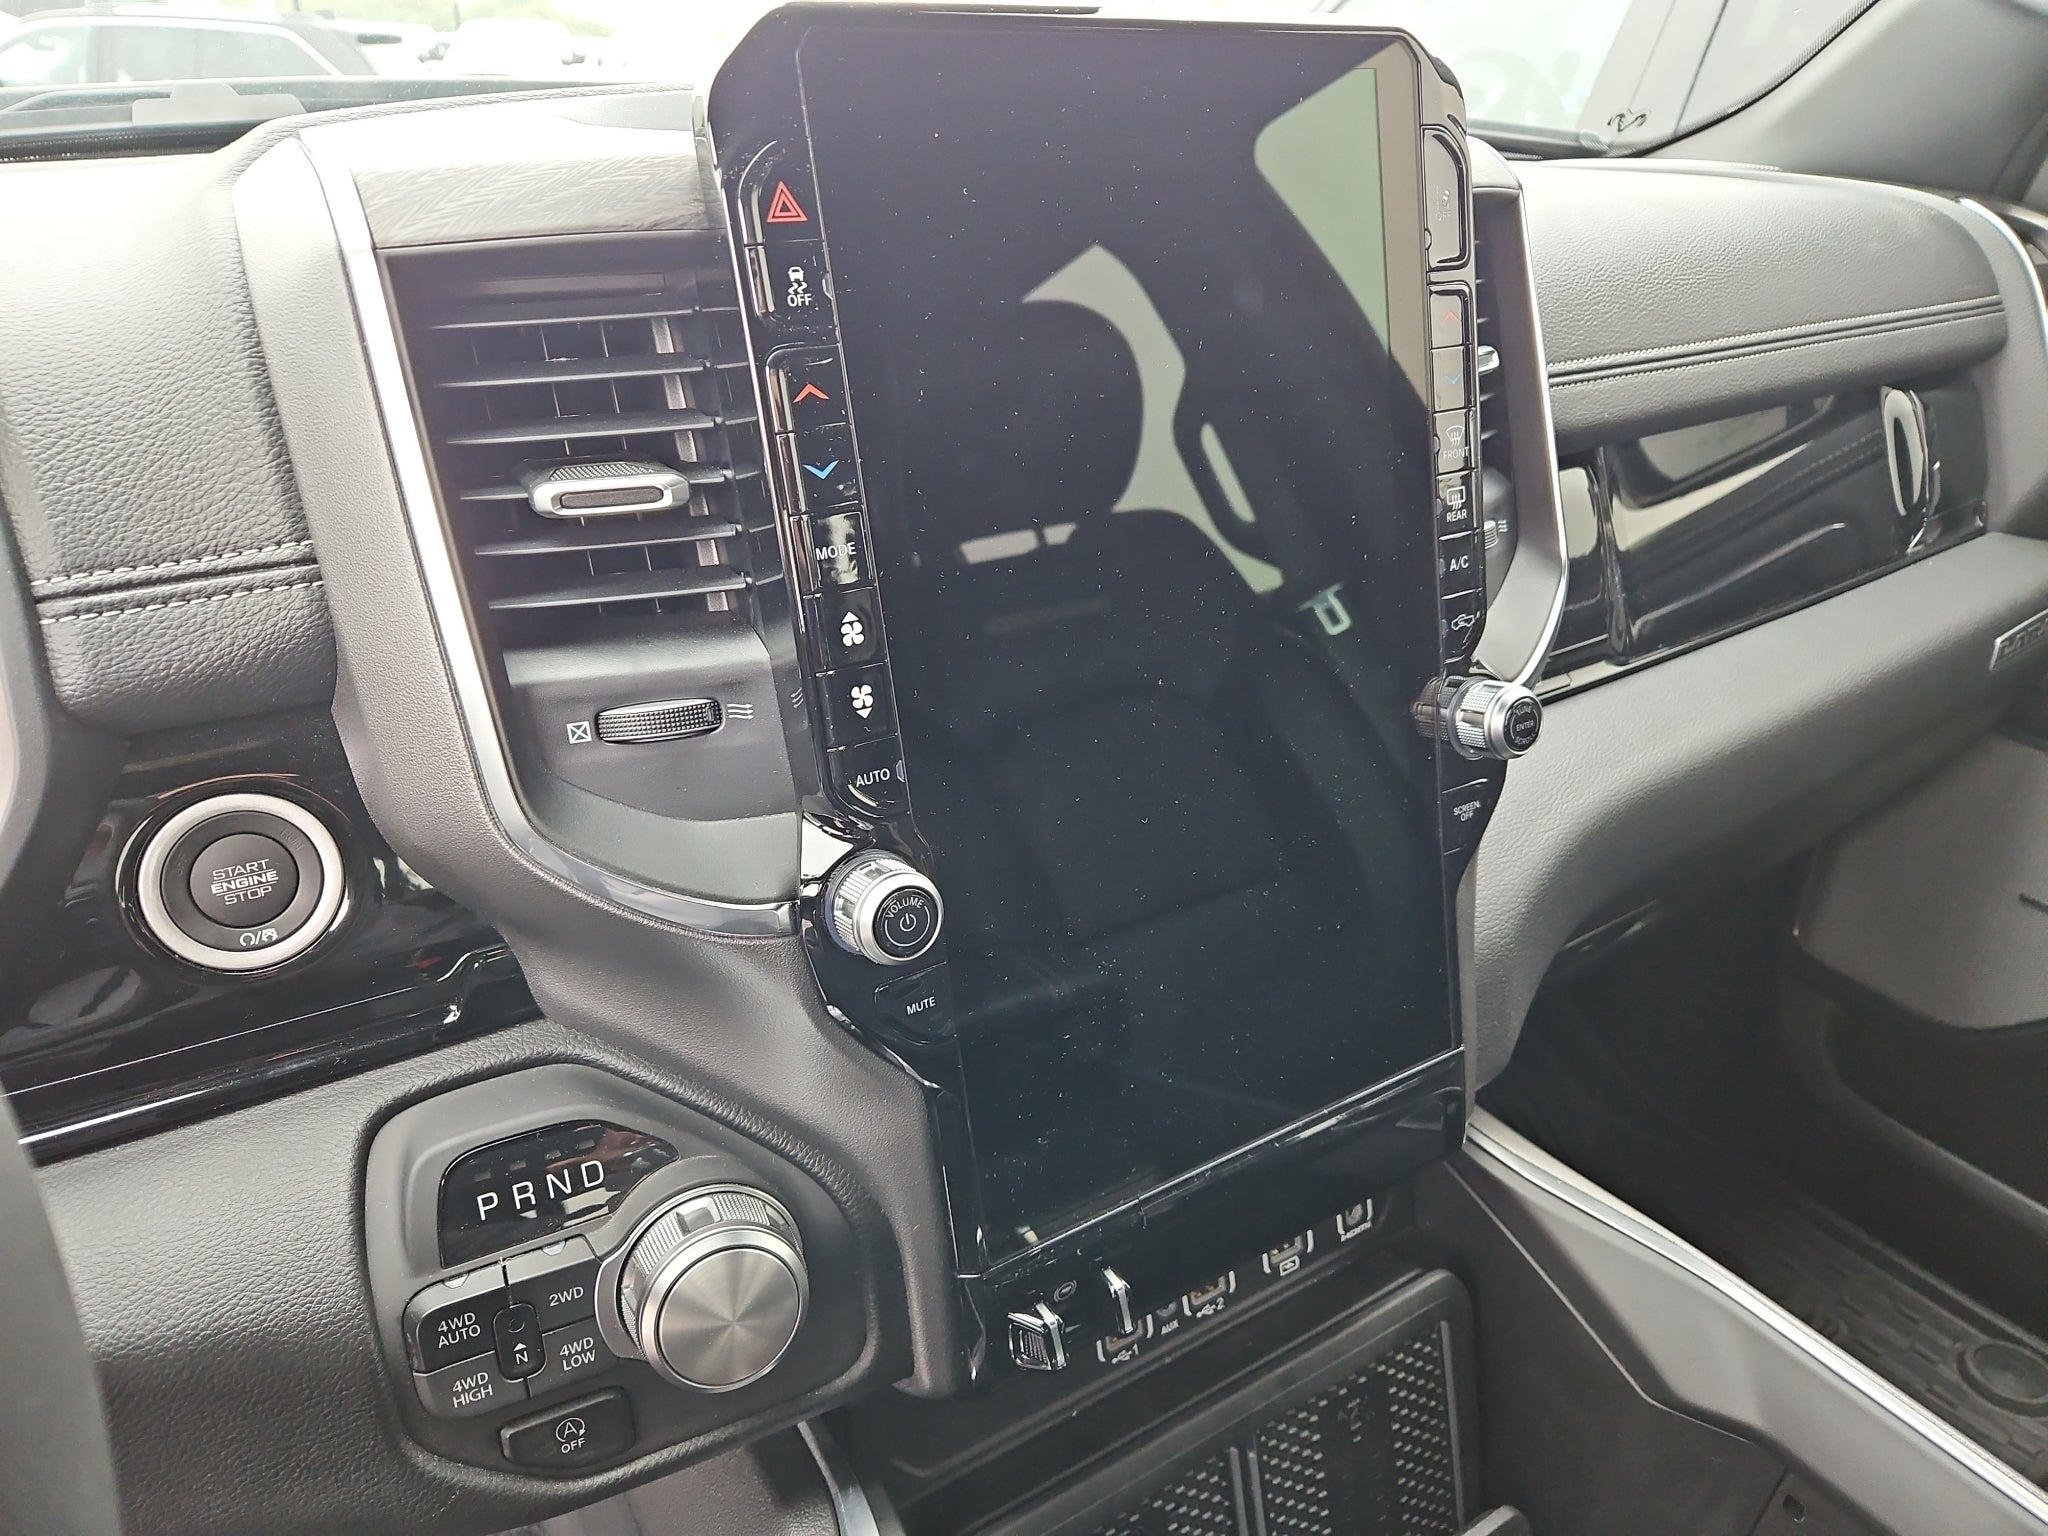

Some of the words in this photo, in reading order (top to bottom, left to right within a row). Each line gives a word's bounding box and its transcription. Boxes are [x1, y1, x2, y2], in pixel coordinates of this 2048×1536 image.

[787, 293, 812, 307] OFF
[1443, 446, 1470, 459] FRONT
[1446, 509, 1467, 522] REAR
[815, 542, 857, 561] MODE
[1449, 555, 1469, 571] A/C
[1516, 720, 1534, 732] ENTER
[856, 768, 890, 787] AUTO
[1453, 800, 1481, 816] SCREEN
[1460, 810, 1475, 822] OFF
[212, 858, 270, 880] START
[210, 870, 279, 894] ENGINE
[224, 885, 273, 905] STOP
[885, 896, 925, 918] VOLUME
[906, 996, 937, 1015] MUTE
[476, 1191, 499, 1221] P
[512, 1181, 537, 1210] R
[546, 1168, 573, 1199] N
[580, 1160, 604, 1188] D
[549, 1286, 584, 1307] 2WD
[438, 1312, 476, 1333] 4WD
[1161, 1319, 1179, 1335] AUX
[438, 1325, 481, 1348] AUTO
[559, 1337, 594, 1357] 4WD
[515, 1351, 529, 1365] N
[562, 1350, 596, 1372] LOW
[452, 1372, 489, 1393] 4WD
[453, 1385, 493, 1408] HIGH
[561, 1437, 586, 1454] OFF
